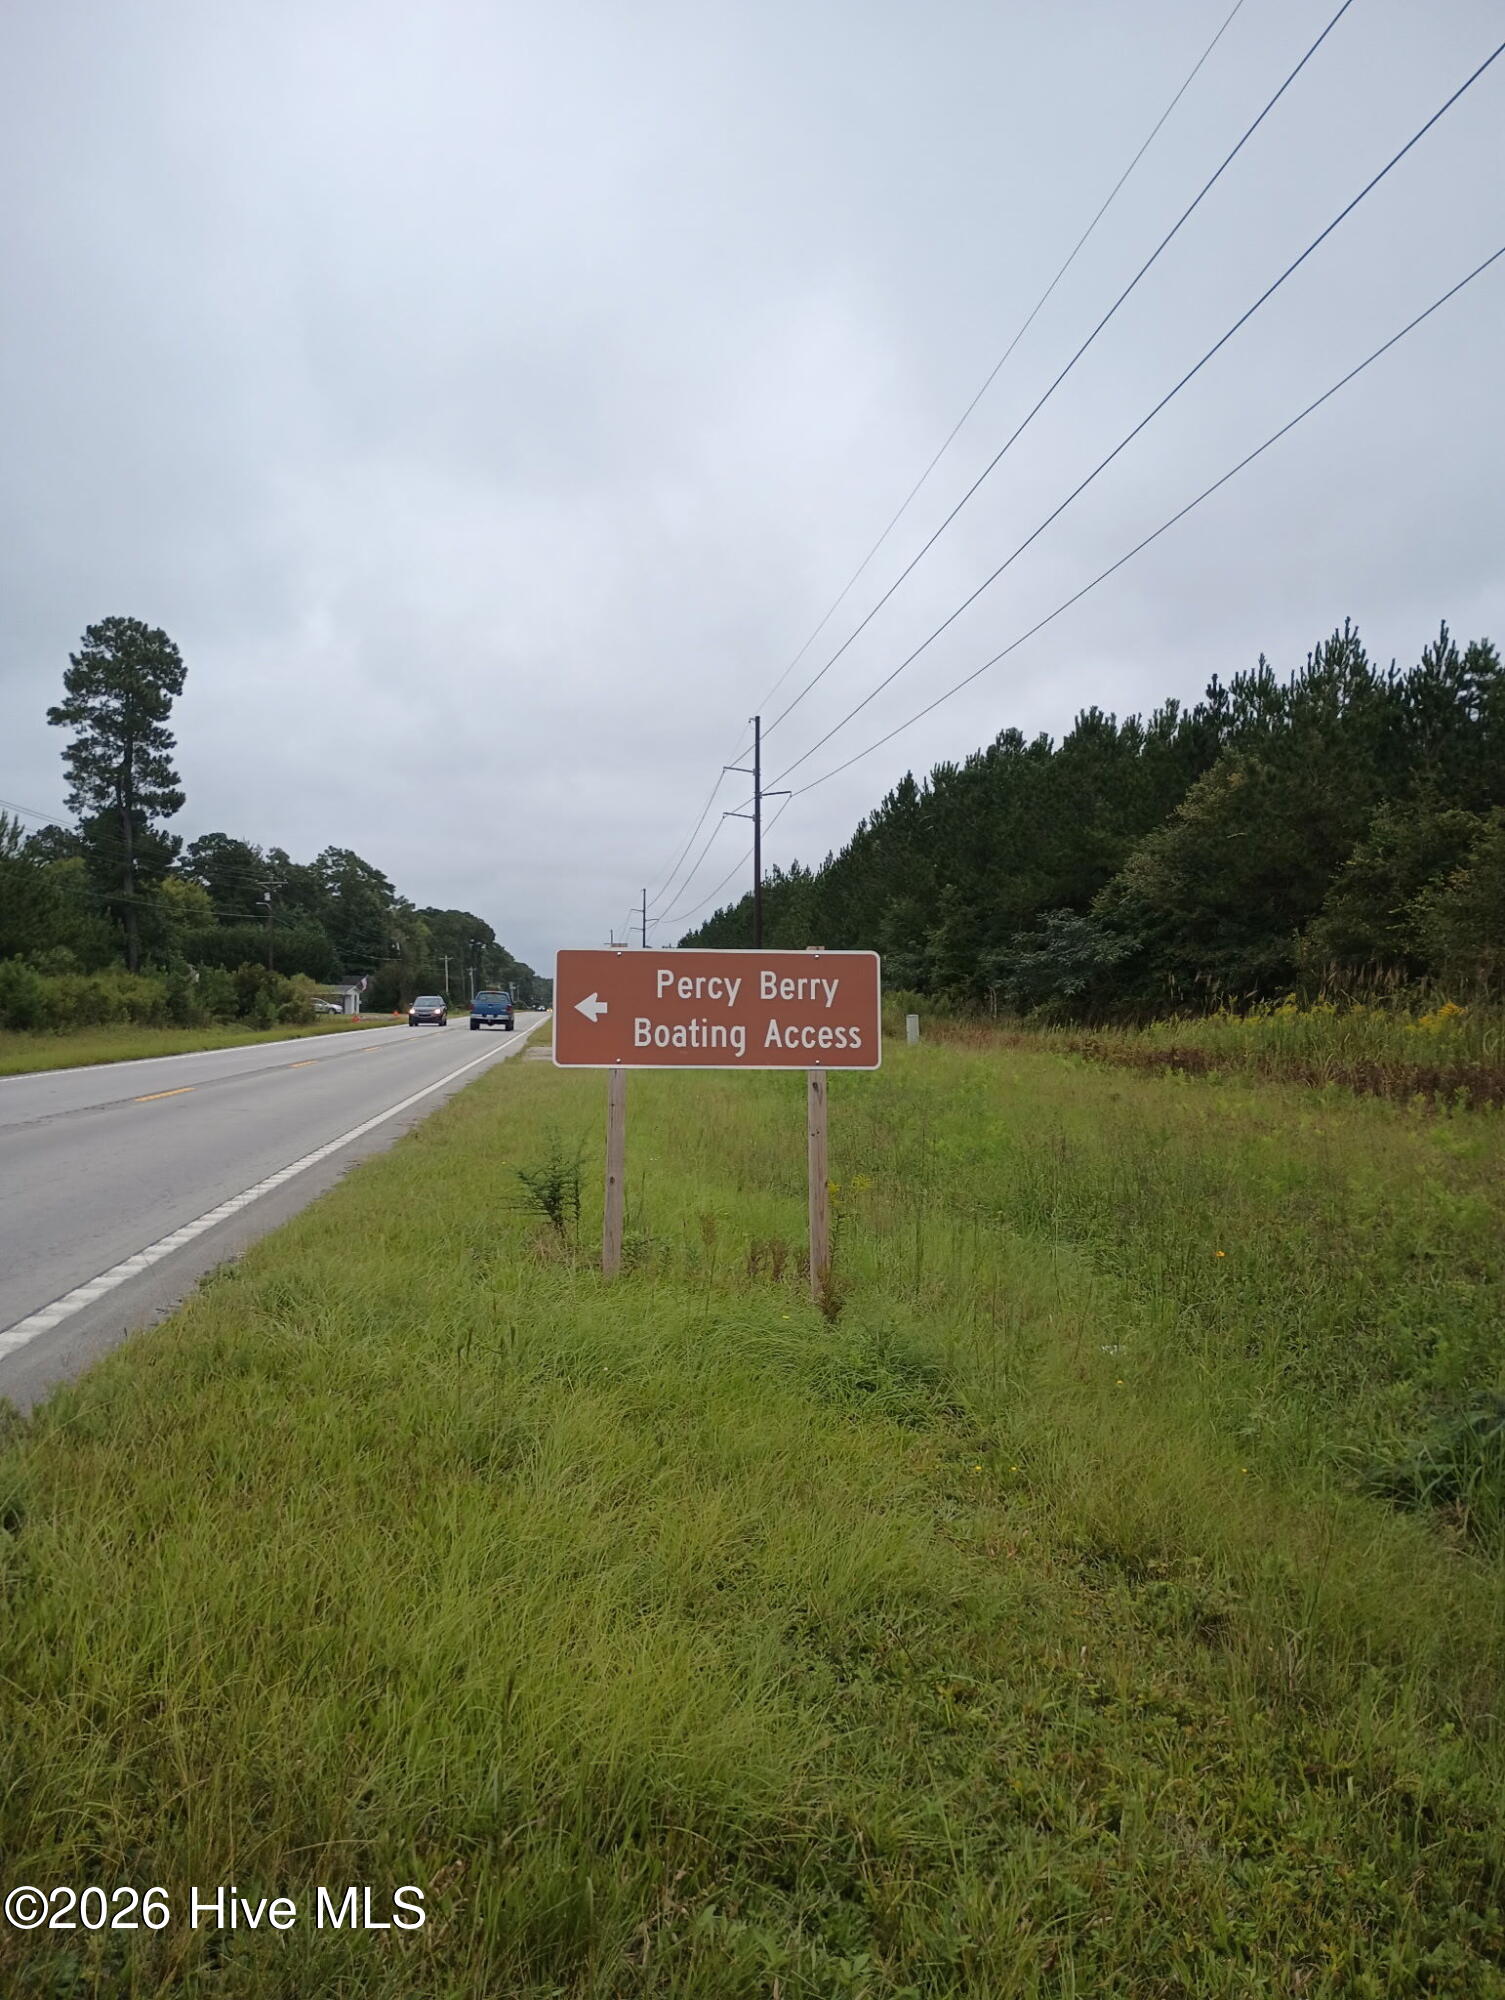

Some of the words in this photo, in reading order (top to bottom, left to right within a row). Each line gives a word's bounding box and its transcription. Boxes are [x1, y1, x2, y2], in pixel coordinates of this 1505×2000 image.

[656, 969, 742, 1007] Percy
[760, 970, 839, 1008] Berry
[634, 1017, 746, 1058] Boating
[763, 1018, 862, 1049] Access
